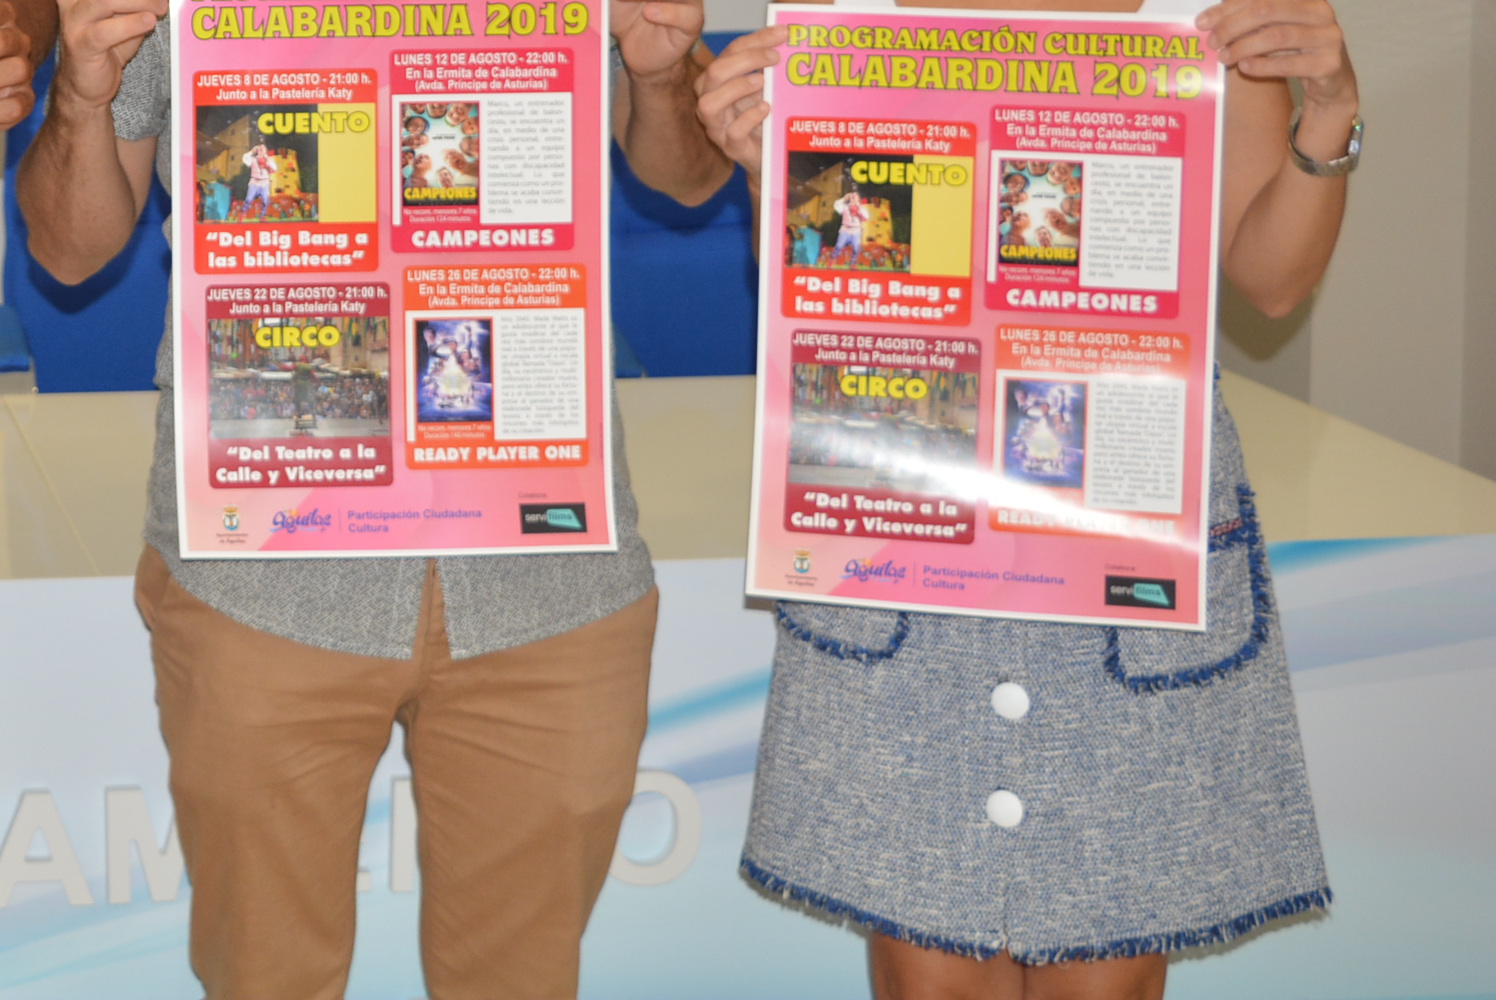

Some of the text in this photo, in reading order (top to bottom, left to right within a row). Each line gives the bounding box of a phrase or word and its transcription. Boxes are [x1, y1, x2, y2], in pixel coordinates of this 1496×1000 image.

[192, 2, 590, 40] CALABARDINA 2019
[787, 25, 1205, 62] PROGRAMACIÓN CULTURAL
[786, 53, 1204, 100] CALABARDINA 2019
[258, 110, 371, 134] CUENTO
[995, 109, 1035, 122] LUNES
[1038, 110, 1052, 122] 12
[1054, 111, 1071, 123] DE
[1073, 111, 1125, 125] AGOSTO
[1134, 114, 1166, 127] 22:00
[1168, 115, 1180, 128] h.
[851, 159, 969, 188] CUENTO
[403, 187, 477, 201] CAMPEONES
[259, 230, 291, 250] Big
[298, 230, 348, 250] Bang
[355, 233, 368, 245] a
[411, 228, 555, 248] CAMPEONES
[208, 252, 237, 268] las
[1000, 244, 1077, 262] CAMPEONES
[207, 288, 252, 301] JUEVES
[254, 288, 267, 300] 22
[269, 288, 286, 300] DE
[287, 287, 336, 299] AGOSTO
[345, 286, 375, 298] 21:00
[376, 286, 388, 298] h.
[848, 278, 881, 299] Big
[888, 280, 941, 303] Bang
[947, 287, 961, 300] a
[795, 296, 825, 314] las
[1006, 289, 1158, 314] CAMPEONES
[254, 325, 341, 348] CIRCO
[839, 372, 929, 402] CIRCO
[275, 445, 334, 460] Teatro
[339, 448, 351, 459] a
[357, 443, 376, 459] la
[414, 444, 581, 462] READY PLAYER ONE
[215, 466, 262, 482] Calle
[268, 470, 279, 484] y
[853, 493, 914, 512] Teatro
[919, 501, 932, 513] a
[938, 498, 957, 515] la
[347, 508, 483, 524] Participación Ciudadana
[791, 512, 838, 529] Calle
[844, 518, 856, 533] y
[348, 525, 389, 535] Cultura
[923, 579, 965, 592] Cultura
